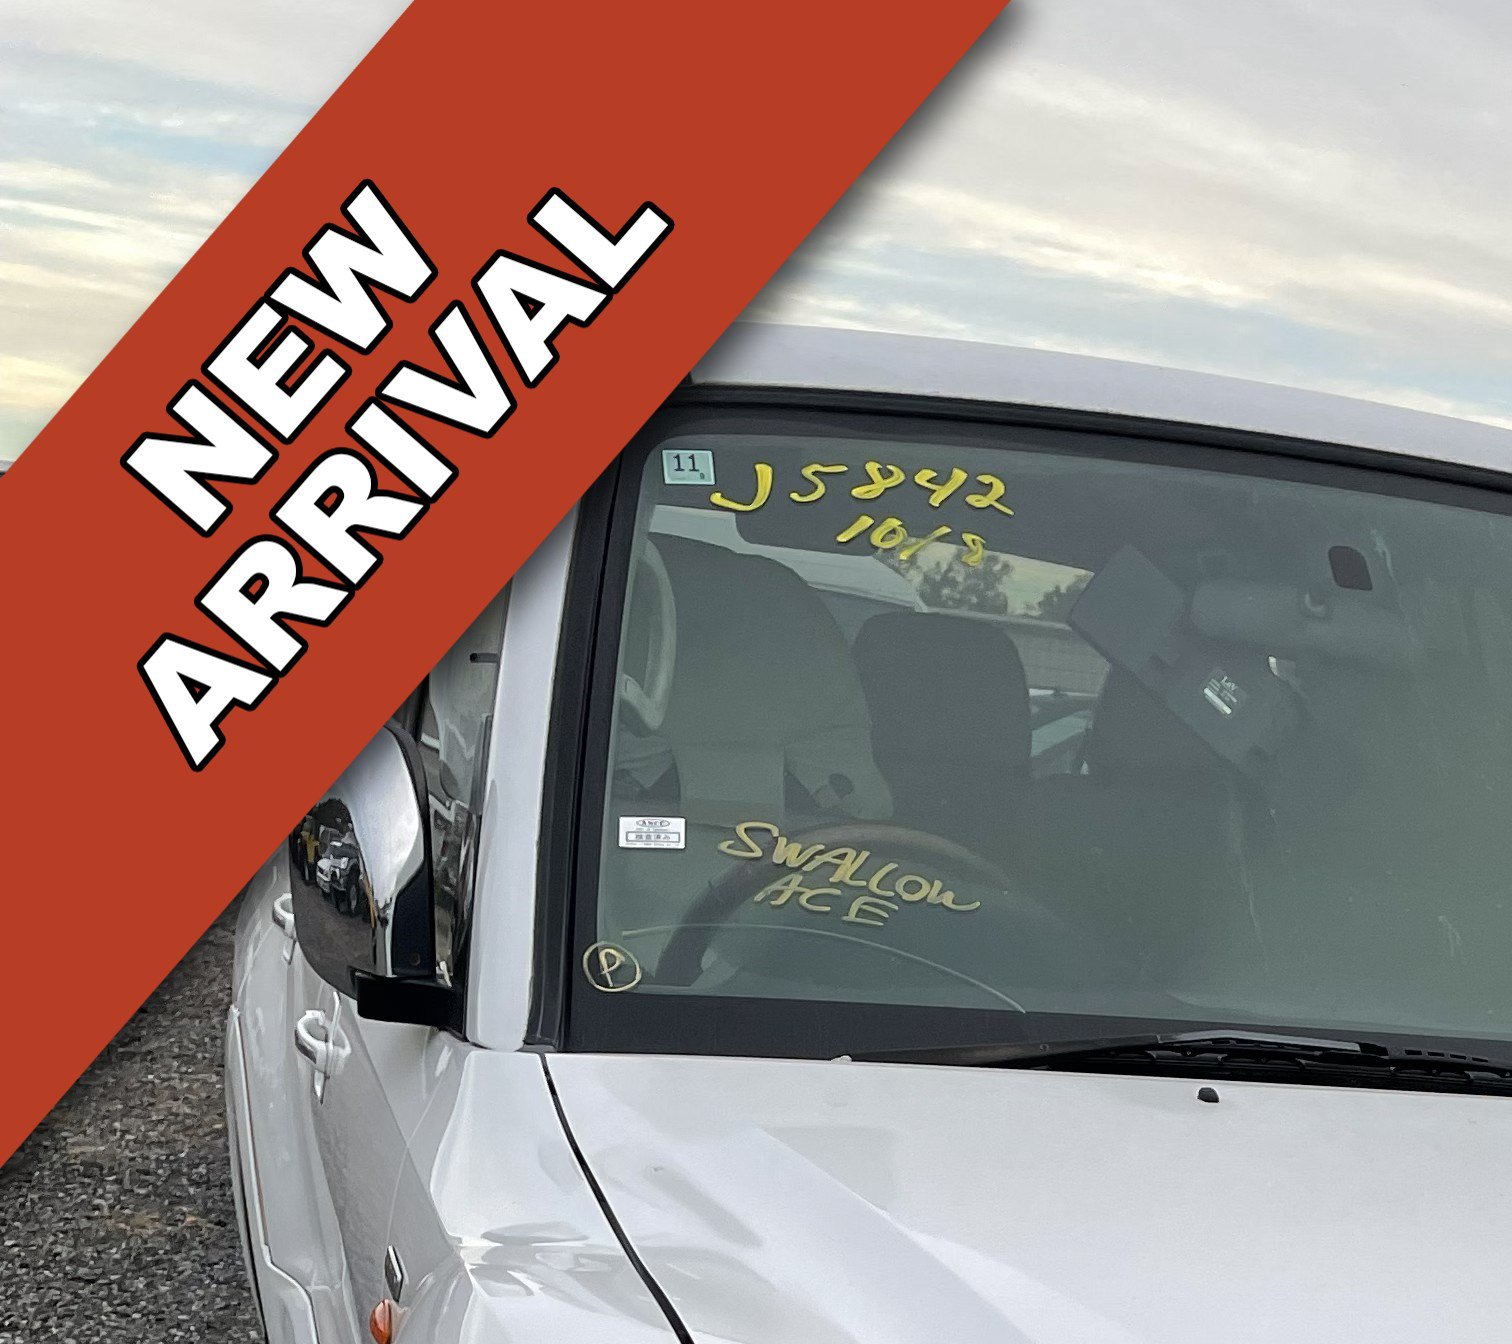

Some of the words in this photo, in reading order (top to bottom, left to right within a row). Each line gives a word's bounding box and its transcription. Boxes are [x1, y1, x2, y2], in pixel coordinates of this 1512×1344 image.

[673, 454, 699, 471] 11
[718, 821, 981, 911] SWALLOW
[754, 874, 899, 926] ACE
